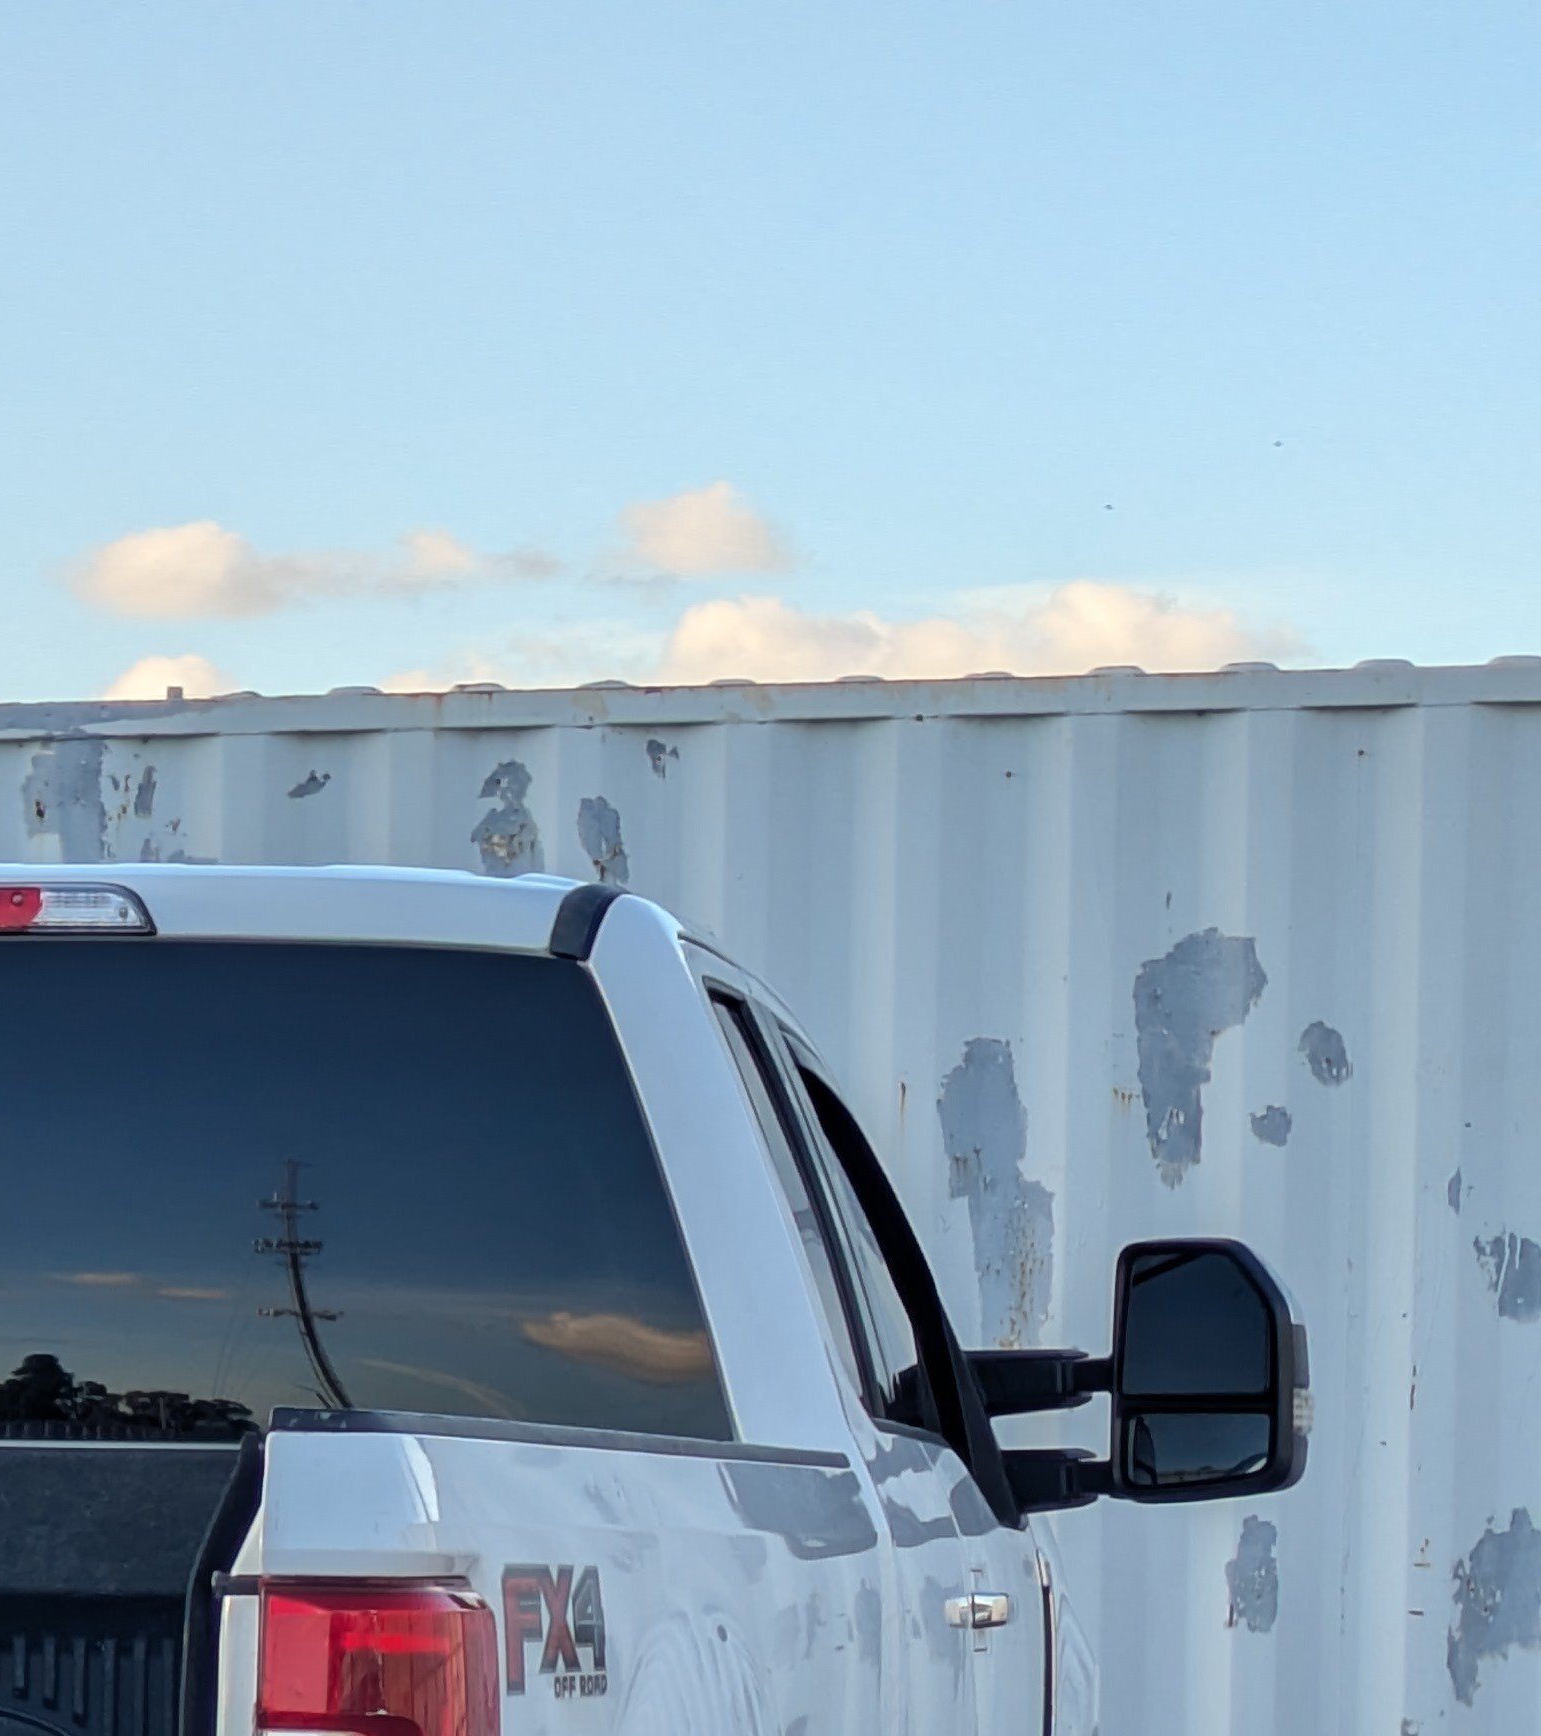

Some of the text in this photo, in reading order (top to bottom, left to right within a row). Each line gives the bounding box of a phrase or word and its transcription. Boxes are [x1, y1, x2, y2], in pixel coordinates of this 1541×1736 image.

[502, 1564, 606, 1695] FX4
[554, 1674, 608, 1699] OFF ROAD
